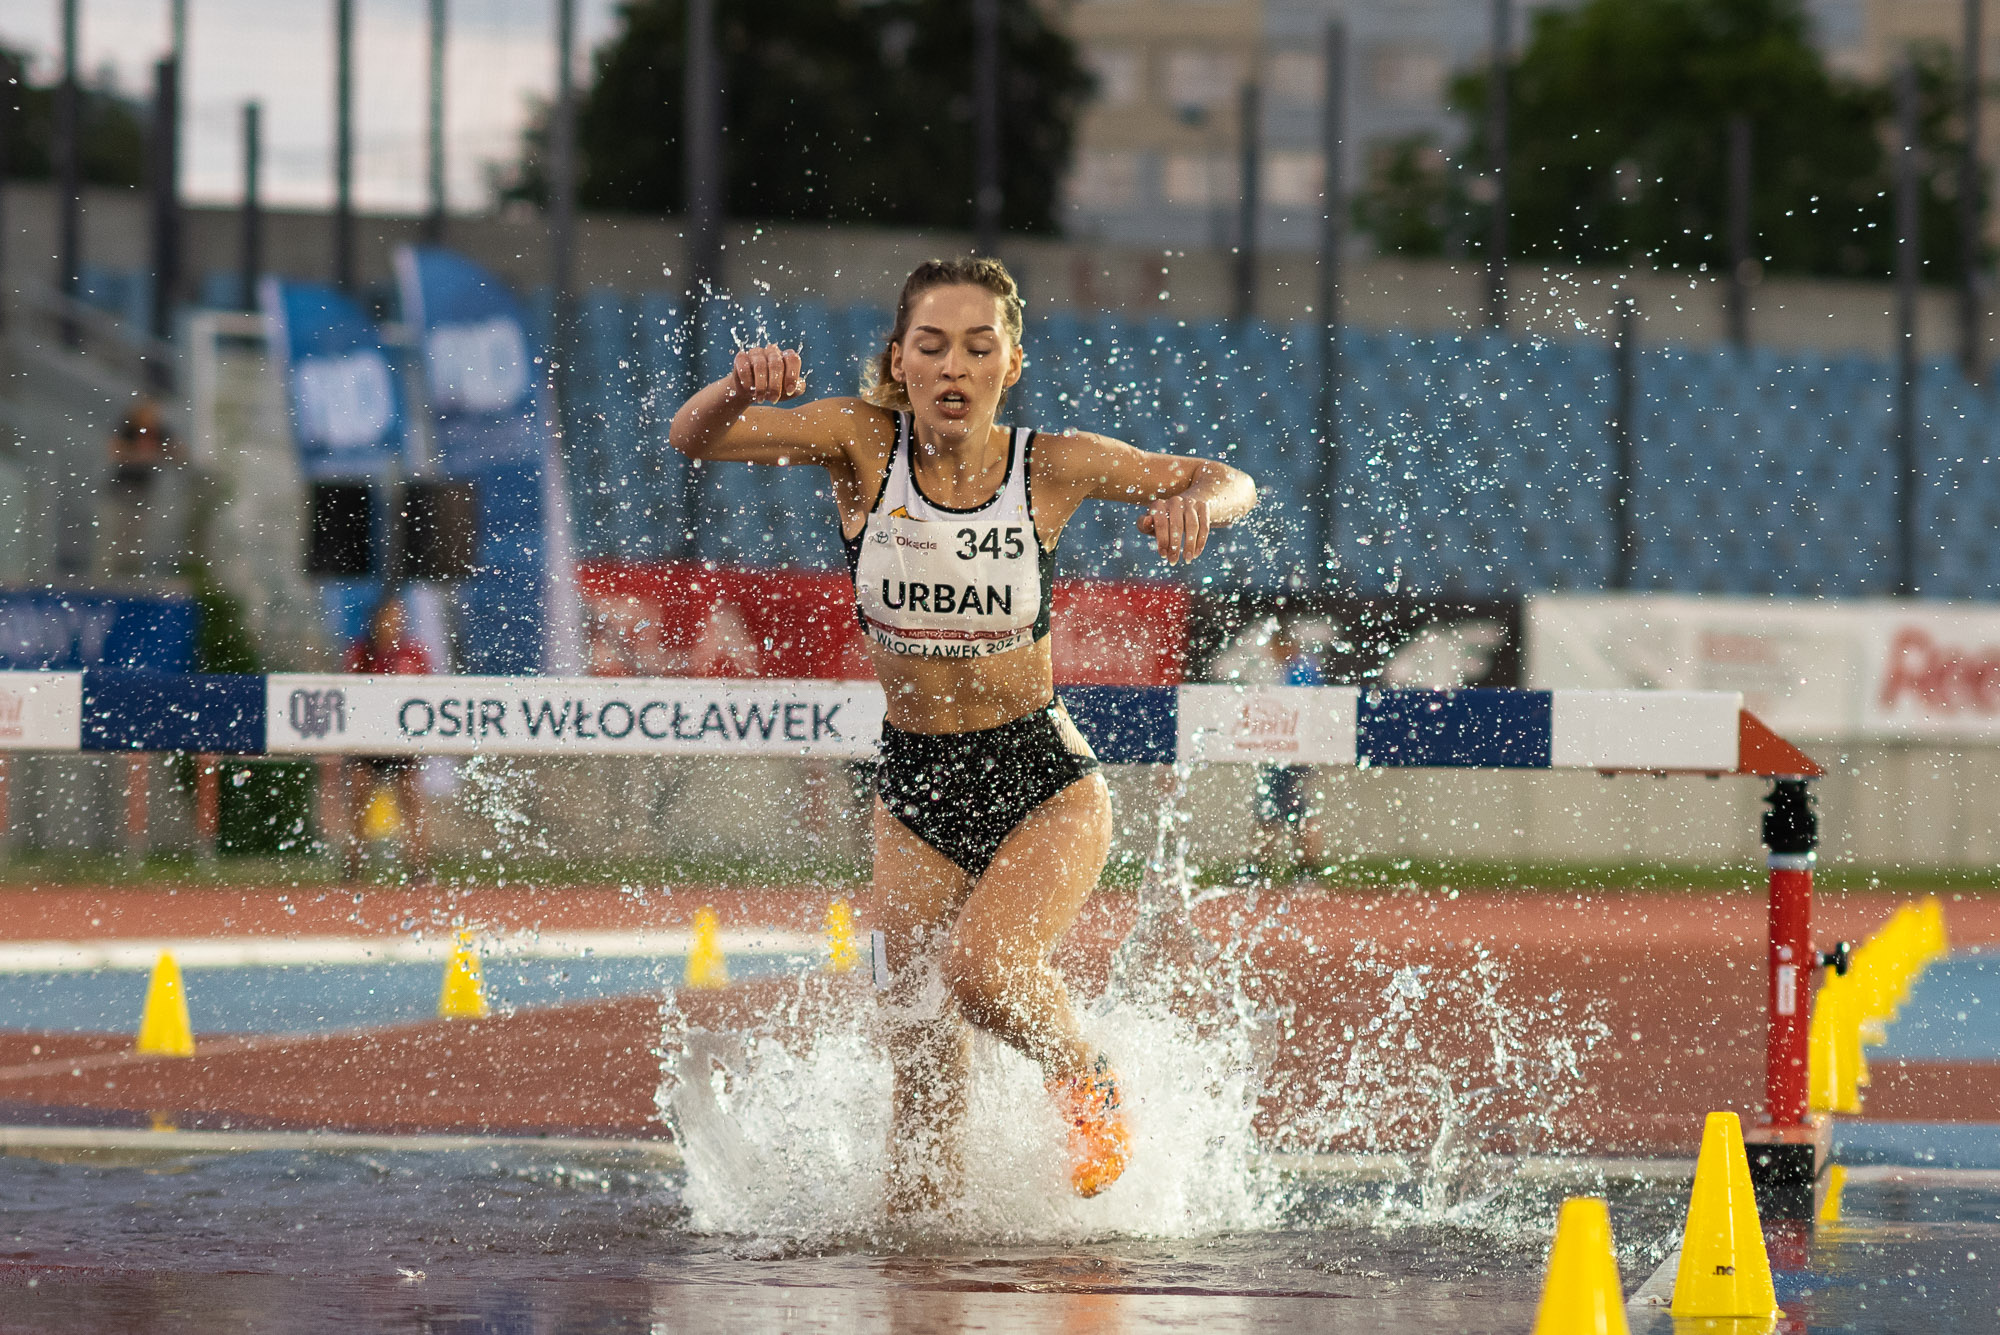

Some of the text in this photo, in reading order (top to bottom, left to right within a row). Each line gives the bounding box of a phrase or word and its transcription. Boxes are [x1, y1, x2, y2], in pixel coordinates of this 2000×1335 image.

[956, 527, 1024, 560] 345
[882, 579, 1012, 615] URBAN
[521, 700, 842, 742] WŁOCŁAWEK
